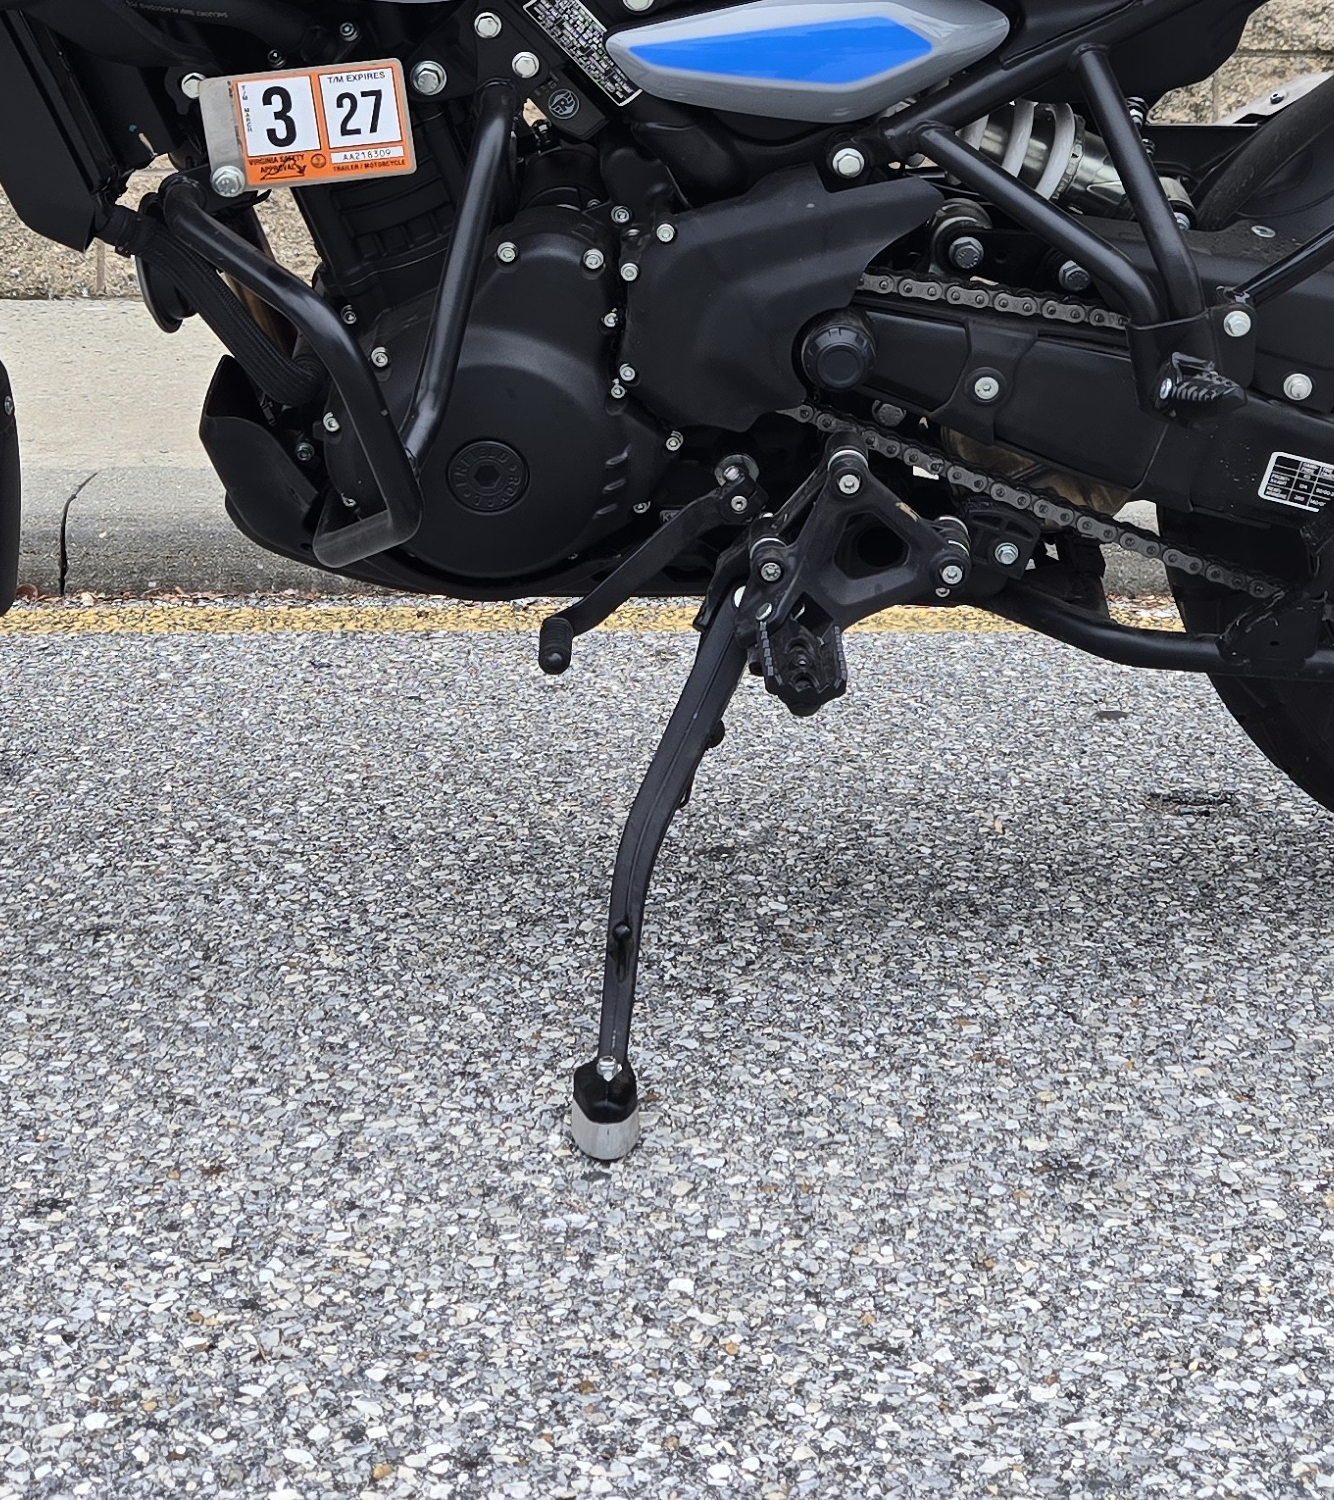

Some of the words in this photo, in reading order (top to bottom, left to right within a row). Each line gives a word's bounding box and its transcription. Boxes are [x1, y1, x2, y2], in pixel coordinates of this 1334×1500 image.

[327, 76, 344, 84] T/M
[346, 71, 386, 83] EXPIRES
[262, 85, 297, 148] 3
[336, 89, 383, 137] 27
[333, 162, 359, 172] TRAILER
[364, 159, 406, 170] MOTORCYCLE
